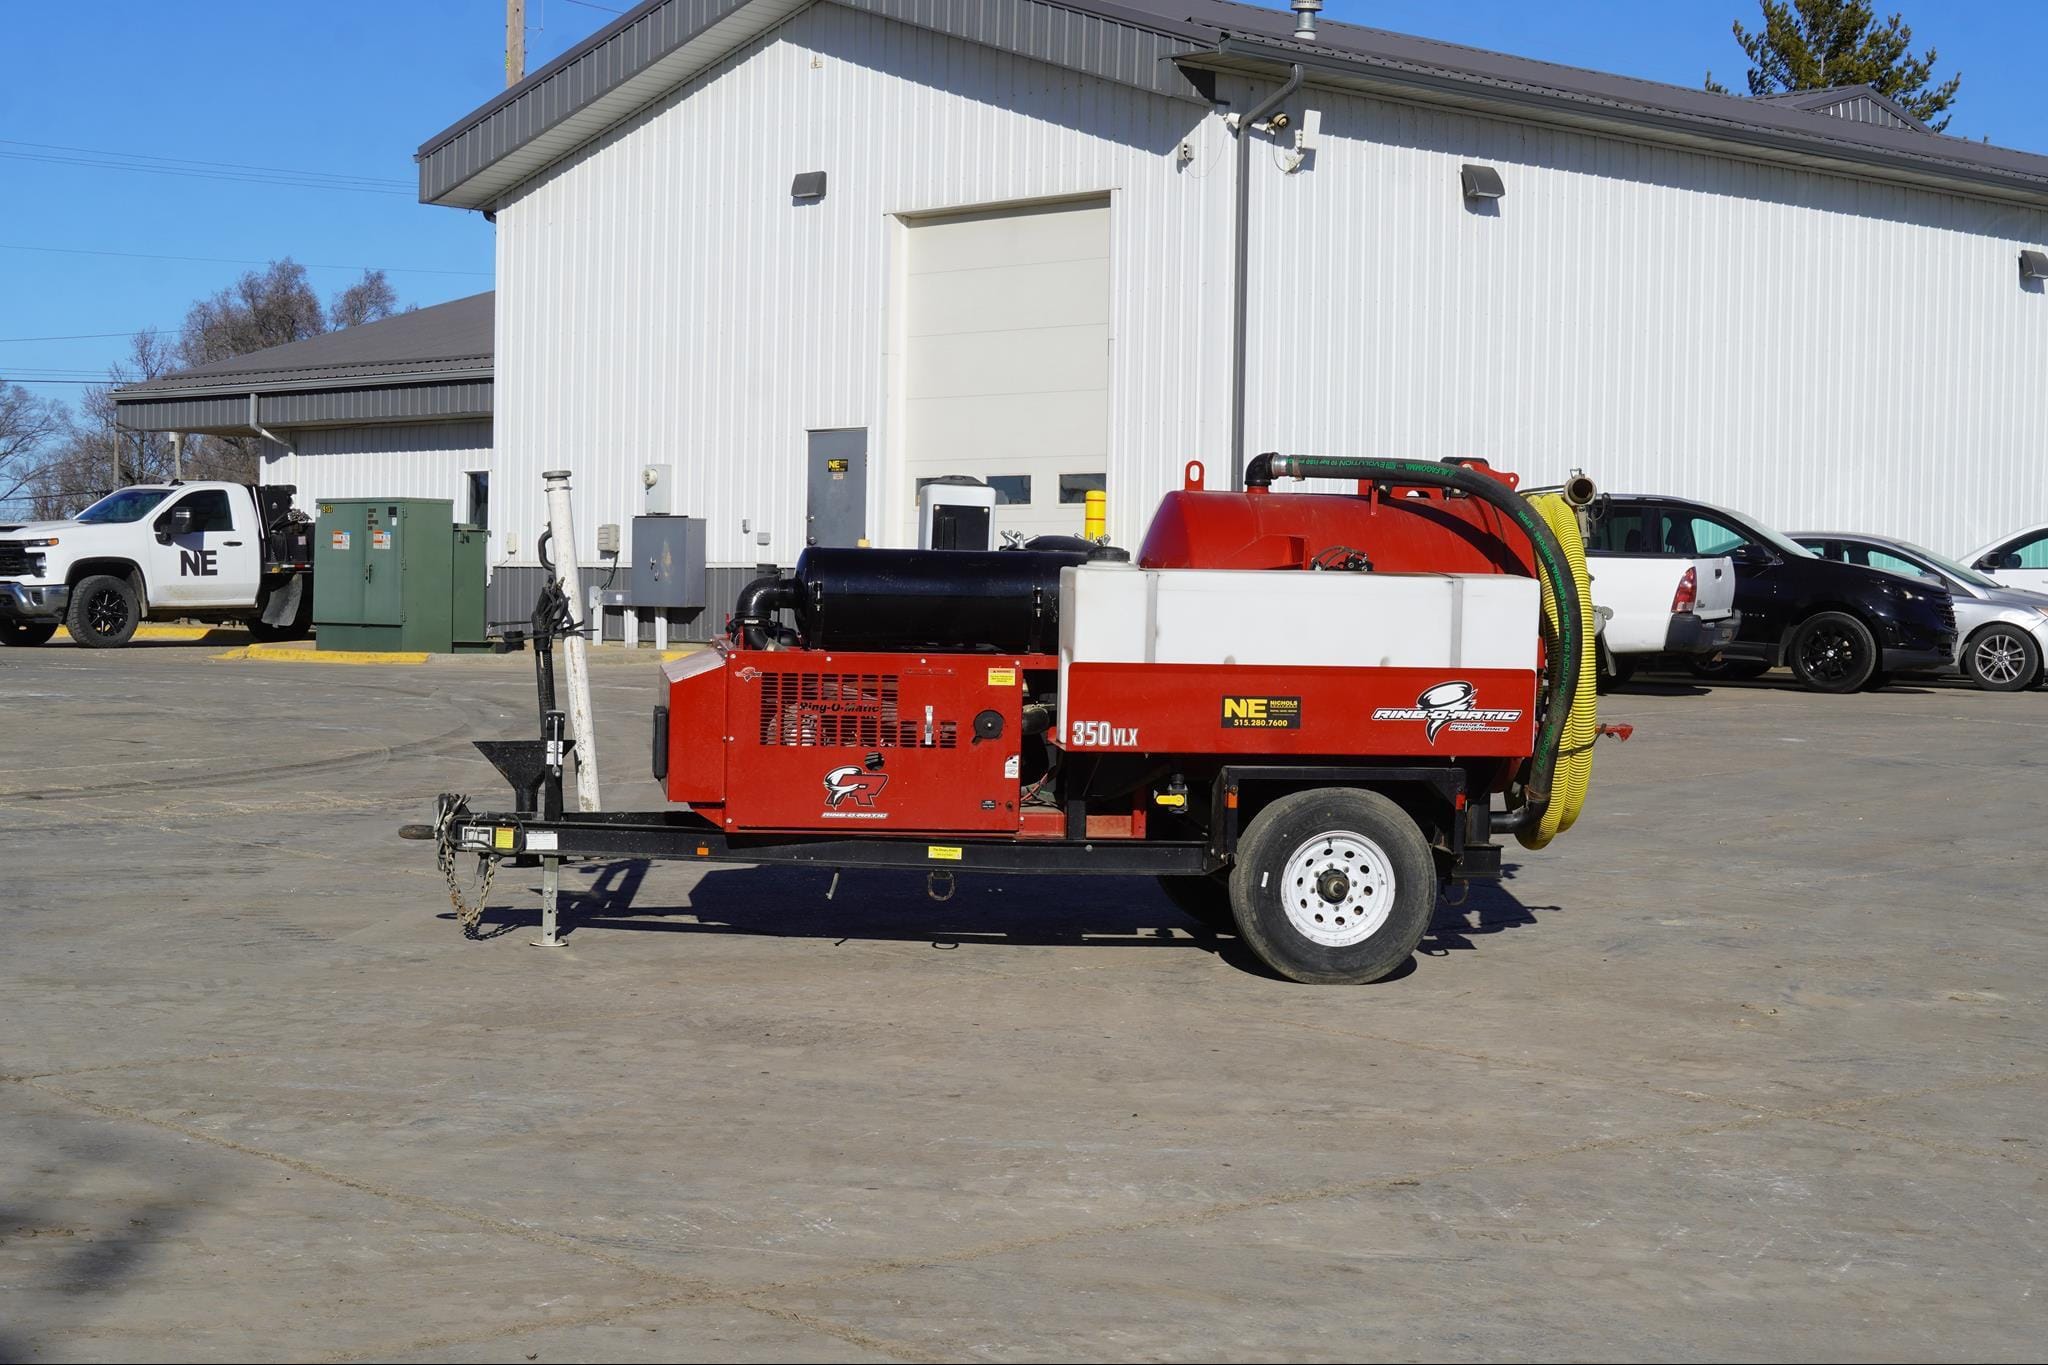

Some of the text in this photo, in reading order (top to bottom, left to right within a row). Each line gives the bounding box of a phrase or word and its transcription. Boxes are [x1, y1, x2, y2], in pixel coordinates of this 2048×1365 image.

[1534, 531, 1555, 564] PURPOSE
[180, 550, 218, 576] NE
[1552, 564, 1566, 600] GENERAL
[1224, 698, 1267, 718] NE
[1373, 709, 1521, 721] RING-O-MATIC
[1073, 720, 1138, 746] 350 VLX
